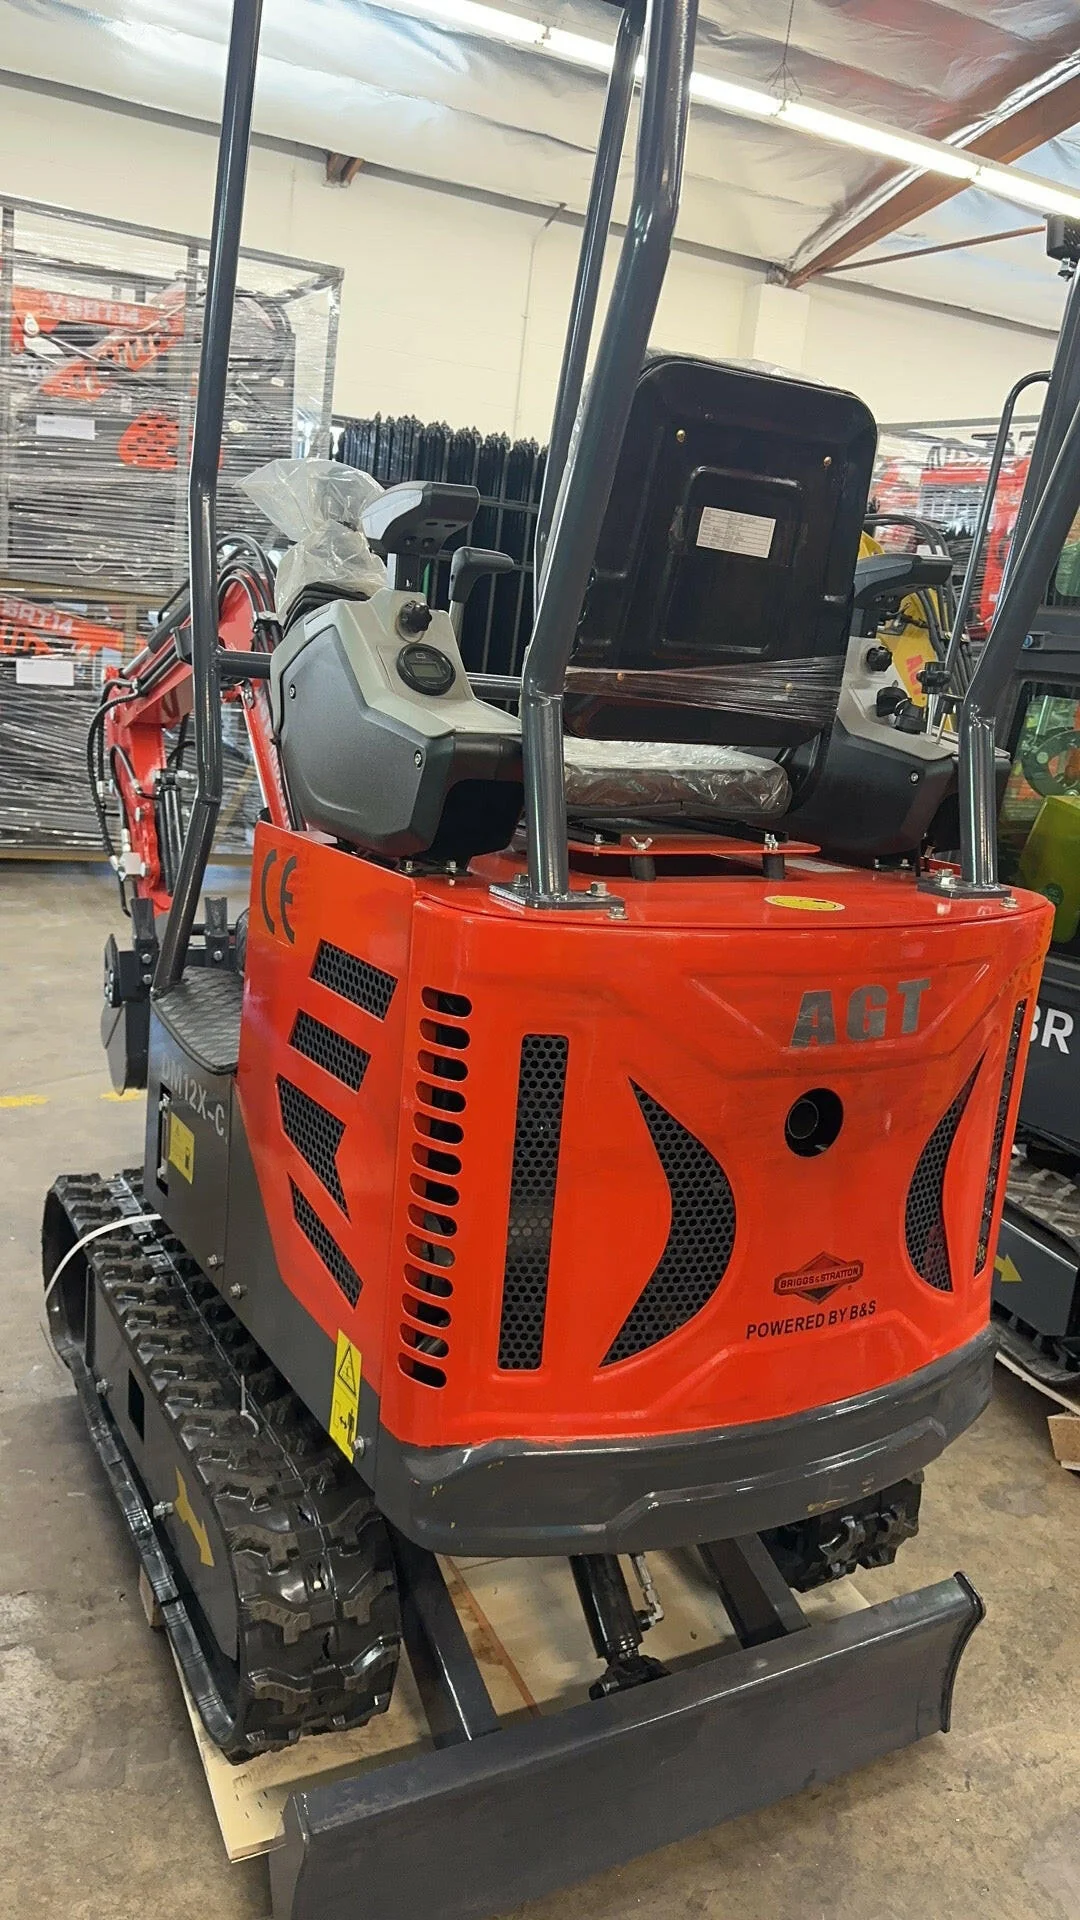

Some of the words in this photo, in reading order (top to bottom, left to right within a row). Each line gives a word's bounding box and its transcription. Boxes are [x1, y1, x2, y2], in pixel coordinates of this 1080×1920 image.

[261, 848, 297, 944] CE
[790, 978, 931, 1049] AGT
[746, 1313, 824, 1339] POWERED
[828, 1307, 848, 1325] BY
[850, 1300, 876, 1320] B&S
